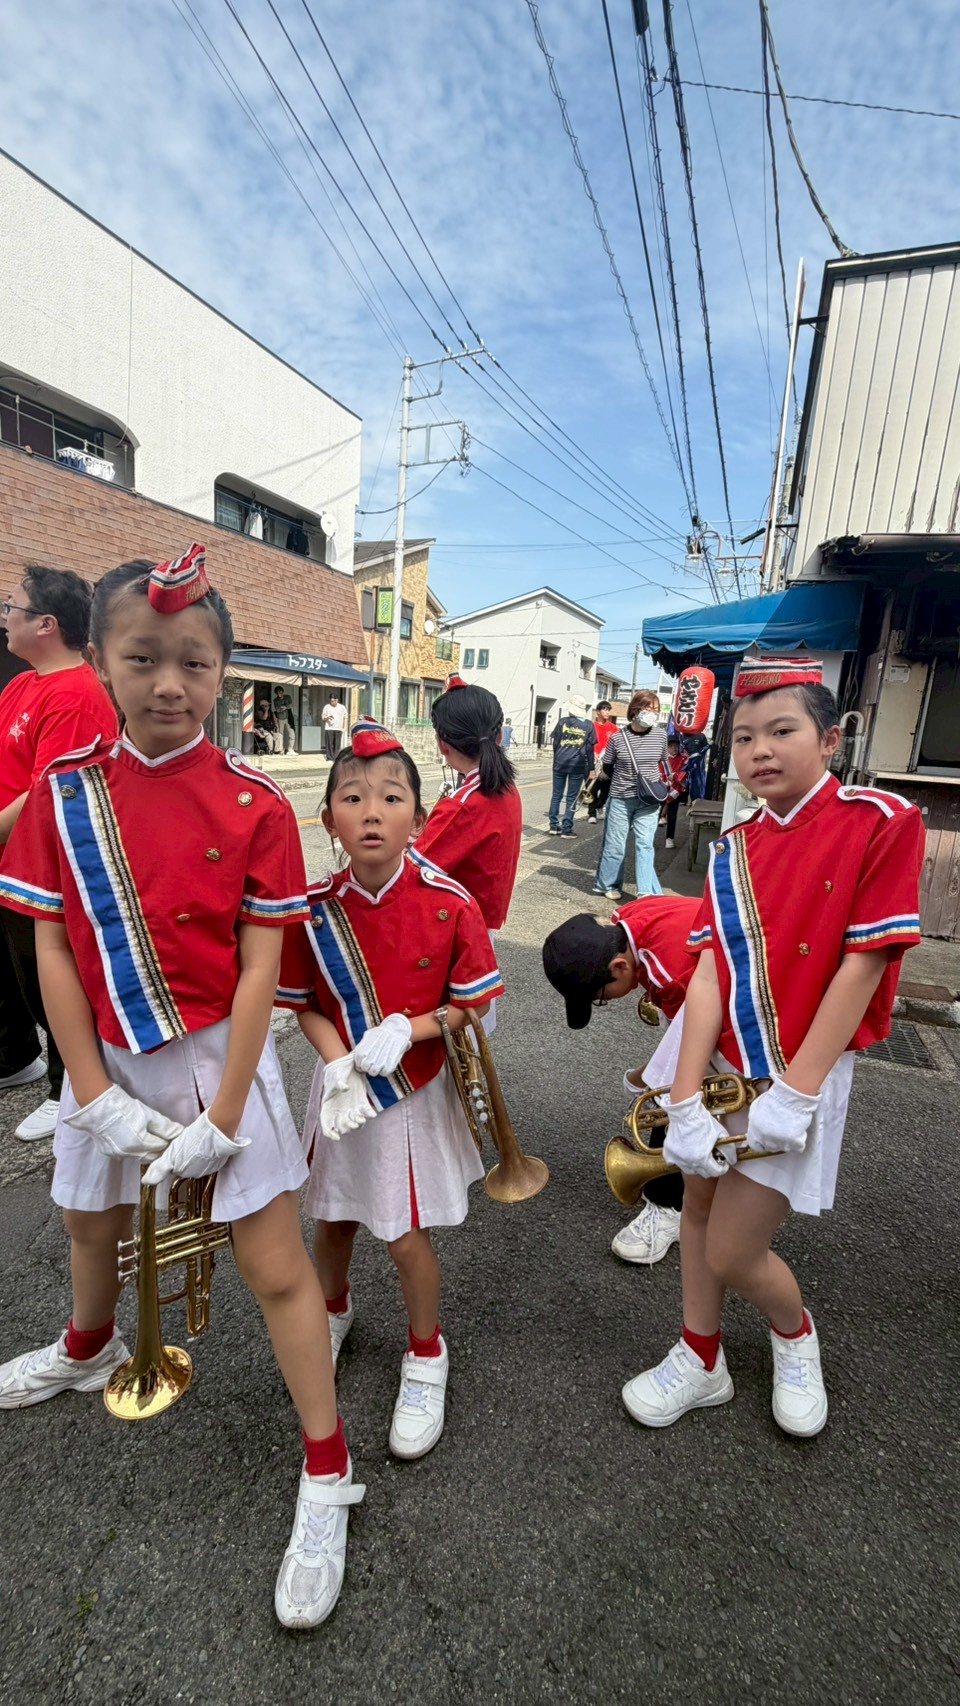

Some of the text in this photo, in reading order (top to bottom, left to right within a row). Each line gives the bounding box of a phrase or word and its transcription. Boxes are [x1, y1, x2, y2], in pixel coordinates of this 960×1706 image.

[741, 673, 782, 686] HADANO
[677, 674, 702, 727] やきとり
